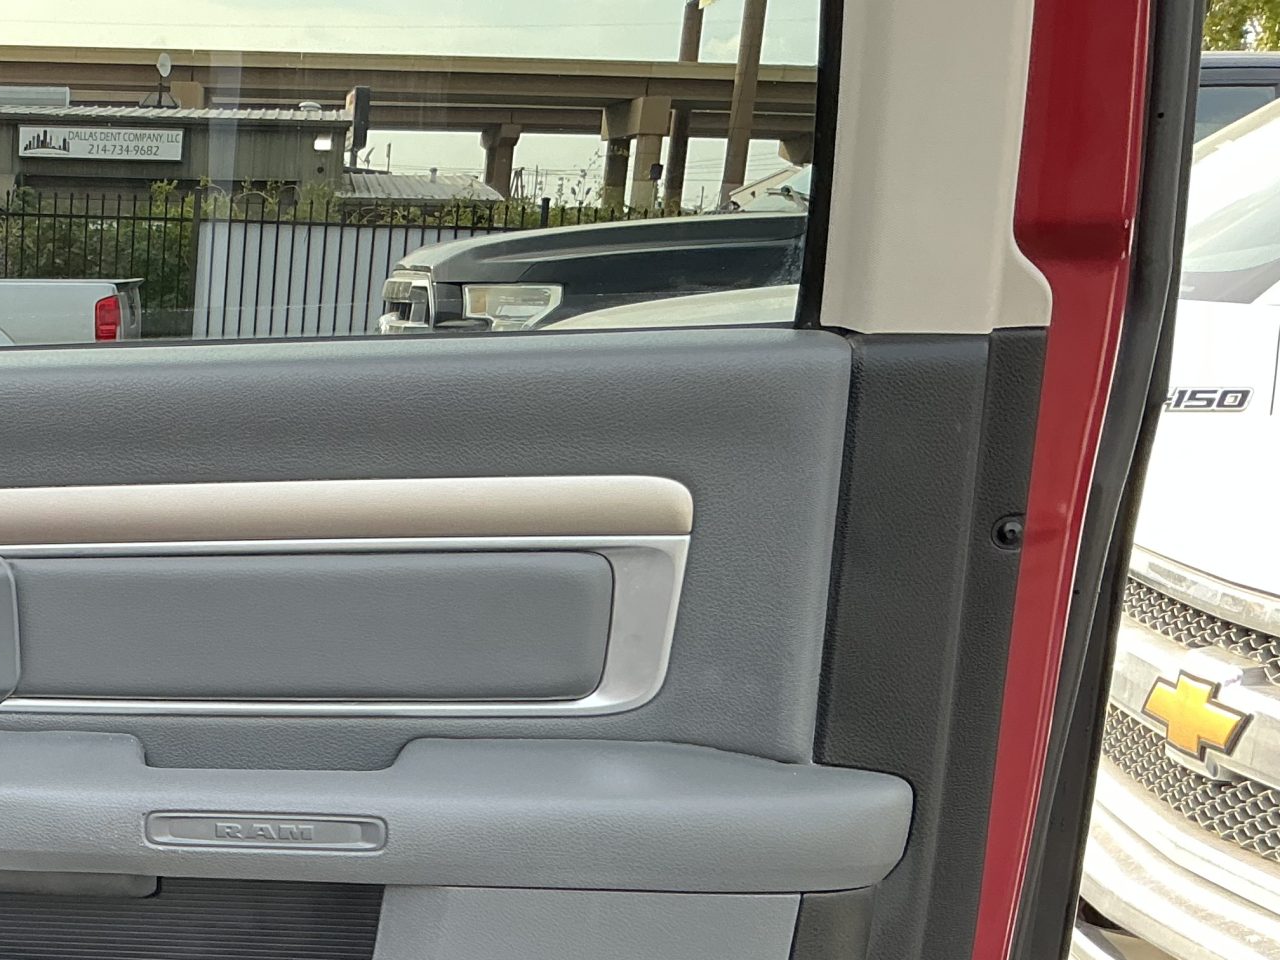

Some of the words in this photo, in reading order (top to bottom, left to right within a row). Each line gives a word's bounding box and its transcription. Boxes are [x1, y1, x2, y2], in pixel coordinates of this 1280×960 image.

[68, 130, 98, 142] DALLAS
[99, 131, 122, 142] DENT
[123, 132, 165, 144] COMPANY,
[166, 133, 180, 144] LLC
[87, 144, 160, 156] 214-734-9682
[214, 822, 314, 840] RAM
